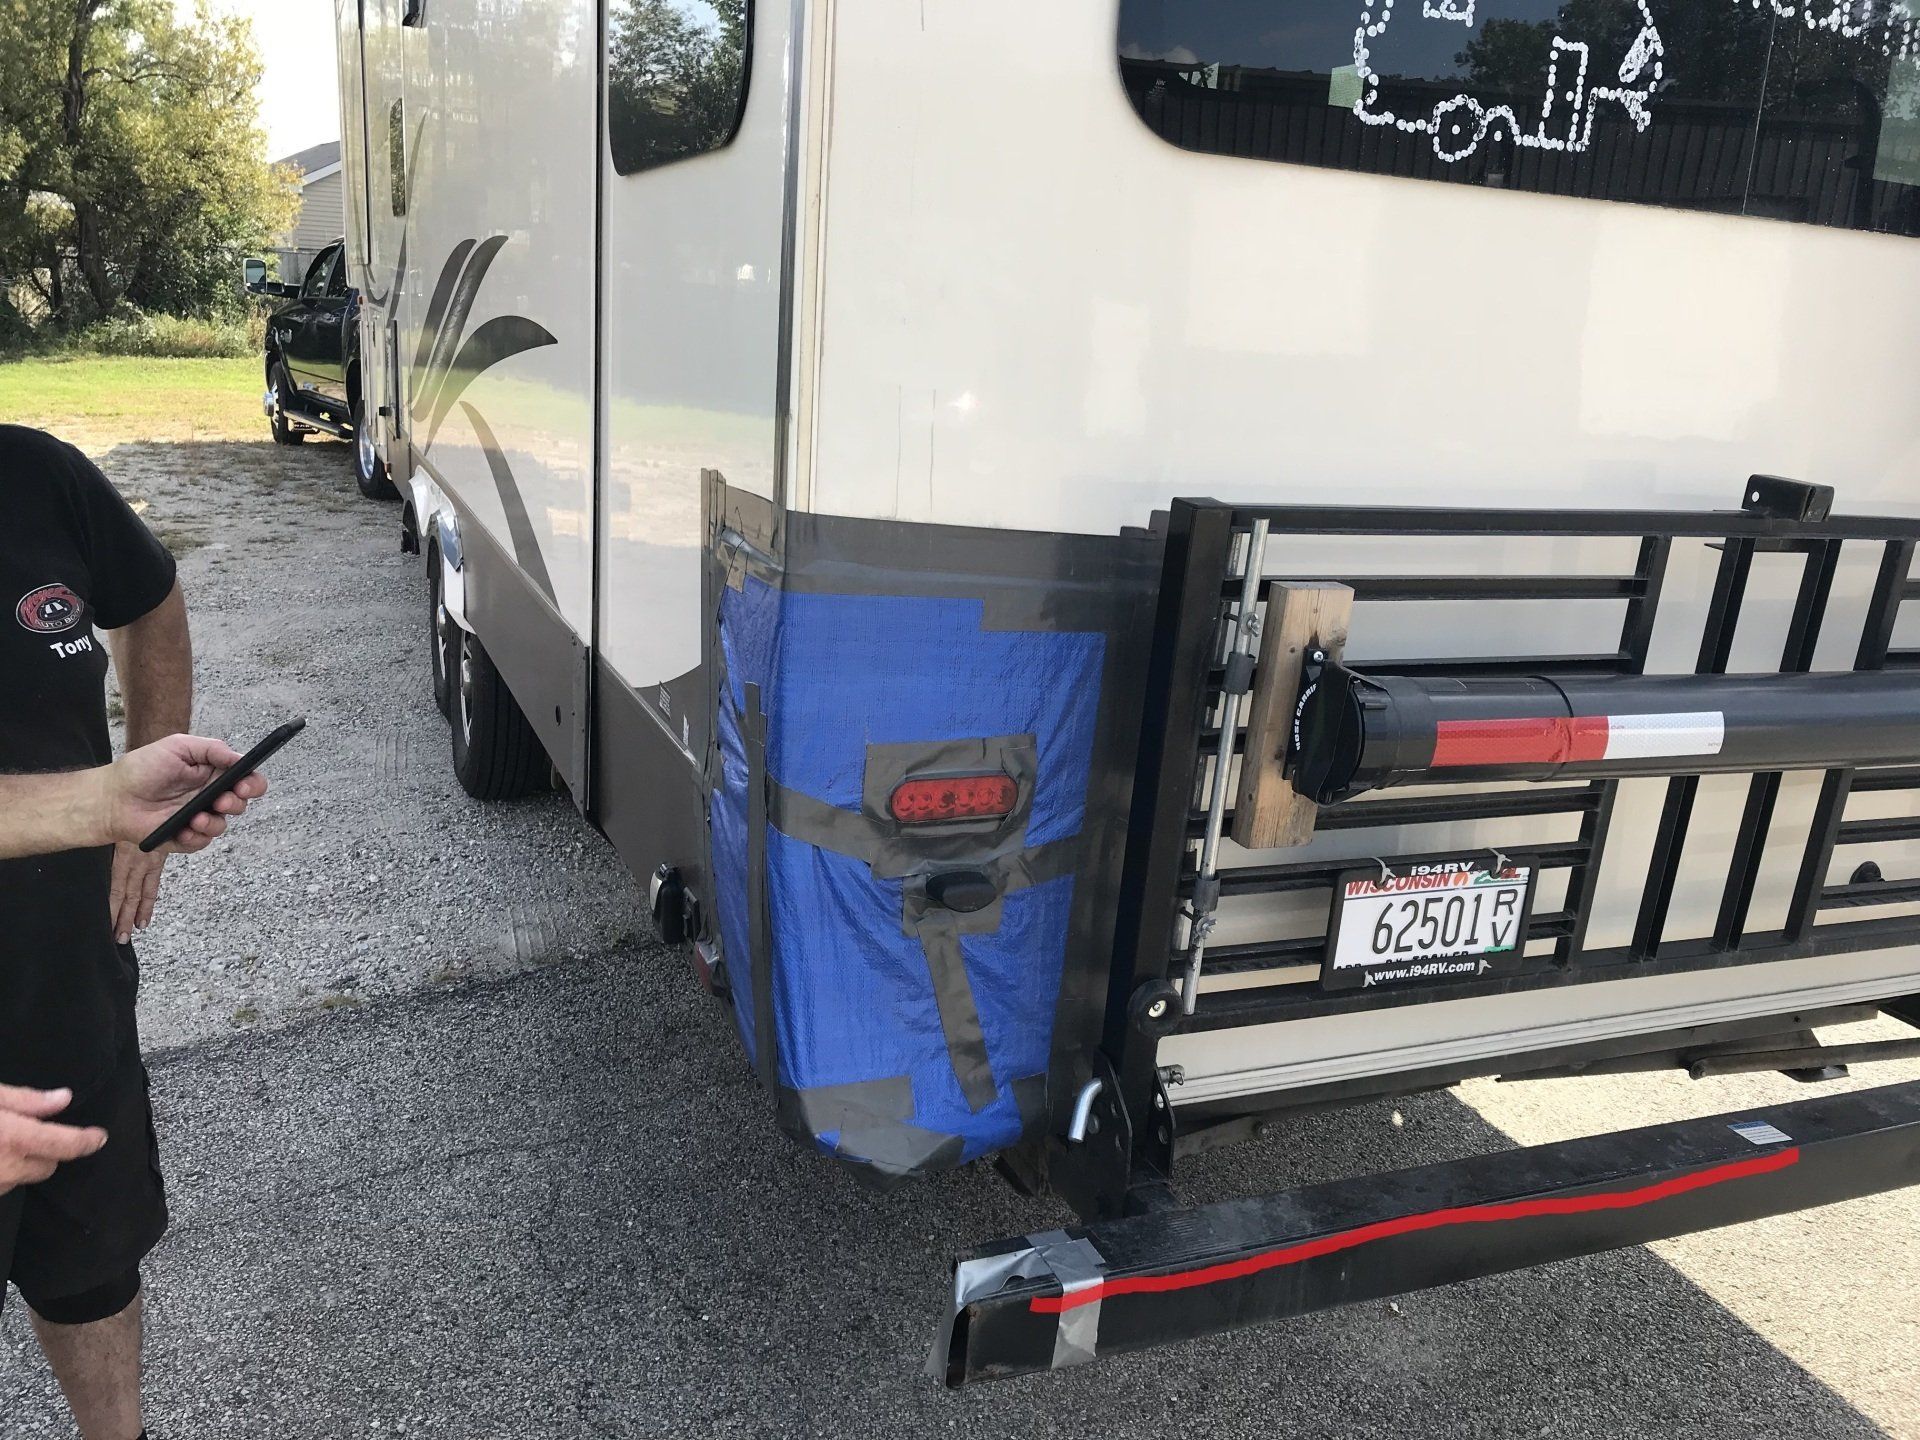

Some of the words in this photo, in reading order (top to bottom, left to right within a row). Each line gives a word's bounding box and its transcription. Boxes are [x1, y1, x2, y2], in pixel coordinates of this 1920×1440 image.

[49, 634, 93, 659] Tony
[1296, 683, 1317, 717] CARRIE
[1410, 861, 1475, 876] i94RV
[1372, 893, 1483, 955] 62501
[1374, 960, 1475, 981] www.i94RV.com
